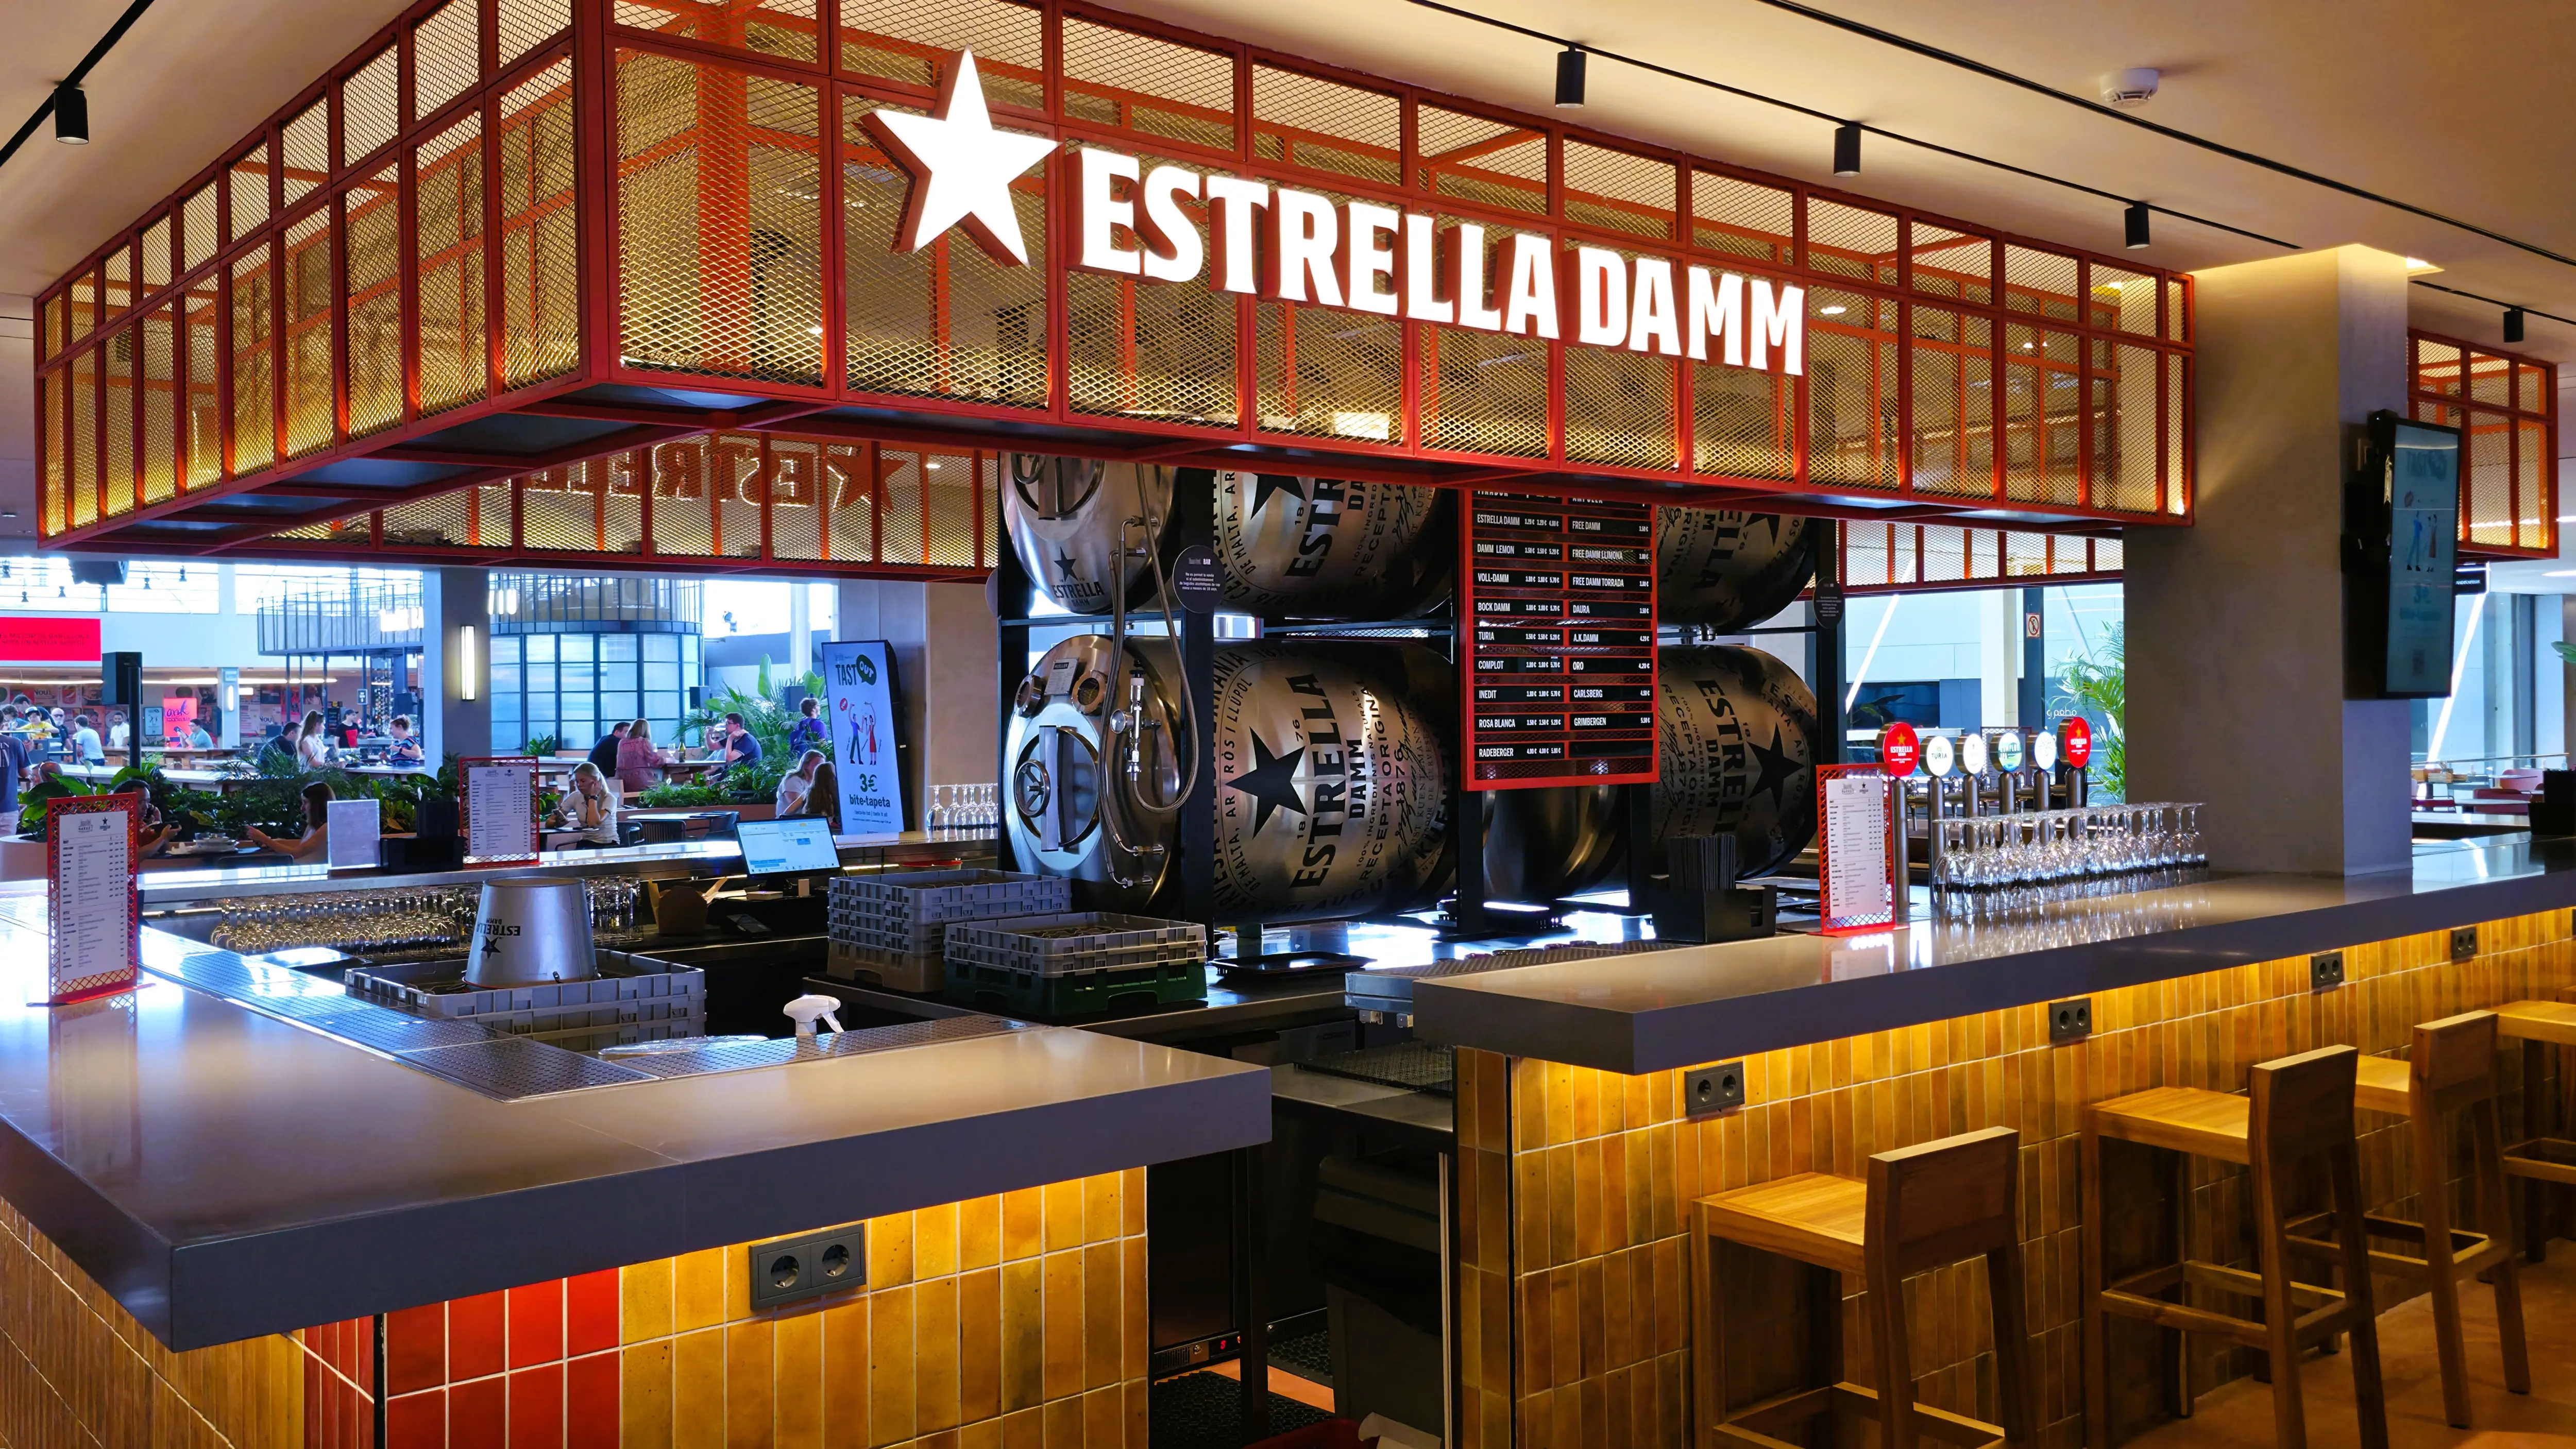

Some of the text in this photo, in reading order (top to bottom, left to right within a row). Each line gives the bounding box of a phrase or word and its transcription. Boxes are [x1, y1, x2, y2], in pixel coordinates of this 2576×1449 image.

[1081, 147, 1805, 377] ESTRELLA DAMM
[1294, 507, 1305, 526] 18
[1477, 514, 1503, 524] ESTRELLA
[1504, 516, 1520, 525] DAMM
[1572, 521, 1584, 530] FREE
[1585, 522, 1600, 531] DAMM
[1478, 544, 1494, 553] DAMM
[1496, 545, 1515, 554] LEMON
[1572, 549, 1584, 558] FREE
[1586, 550, 1600, 558] DAMM
[1601, 551, 1622, 560] LLIMONA
[1478, 573, 1509, 582] VOLL-DAMM
[1573, 577, 1585, 585] FREE
[1602, 578, 1624, 587] TORRADA
[1052, 582, 1105, 599] ESTRELLA
[1478, 603, 1493, 611] BOCK
[1494, 603, 1510, 611] DAMM
[1573, 605, 1590, 613] DAURA
[1479, 632, 1495, 640] TURIA
[1479, 661, 1504, 669] COMPLOT
[1573, 661, 1584, 670] ORO
[835, 661, 874, 686] TAST OUT
[1479, 690, 1497, 698] INEDIT
[1574, 689, 1603, 697] CARLSBERG
[1479, 719, 1494, 727] ROSA
[1495, 719, 1515, 727] BLANCA
[1574, 718, 1606, 726] GRIMBERGEN
[1662, 684, 1697, 773] RECEPTA
[1292, 719, 1304, 742] 76
[1479, 748, 1514, 757] RADEBERGER
[1346, 739, 1367, 819] DAMM
[1350, 690, 1378, 867] 100% INGREDIENTS NATURALS
[1355, 678, 1393, 880] RECEPTA ORIGINAL
[1393, 747, 1405, 807] 1876
[1705, 739, 1720, 808] DAMM
[859, 773, 878, 792] 3€
[1285, 673, 1346, 889] ESTRELLA
[849, 794, 891, 809] bite-tapeta
[1224, 795, 1236, 818] AR
[1296, 820, 1307, 840] 18
[1245, 876, 1261, 891] DE
[477, 923, 521, 936] ESTRELLA
